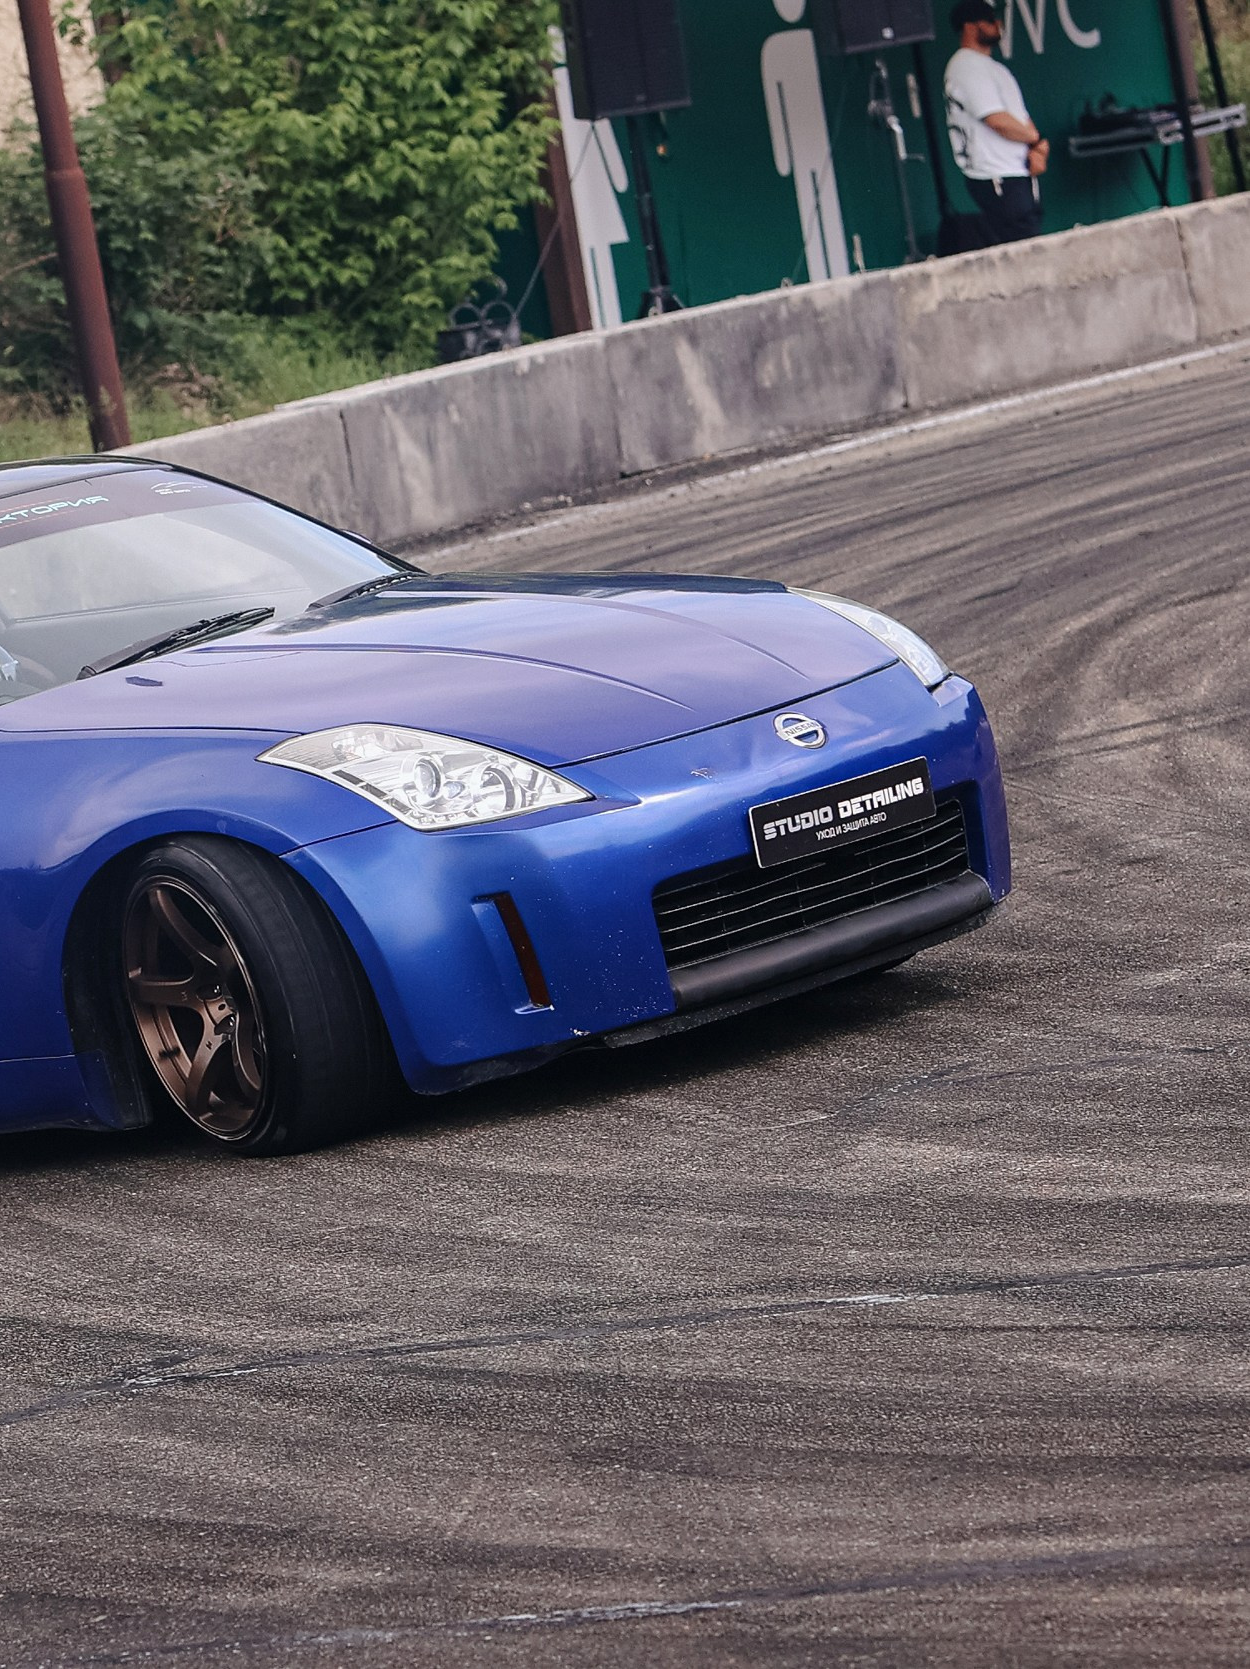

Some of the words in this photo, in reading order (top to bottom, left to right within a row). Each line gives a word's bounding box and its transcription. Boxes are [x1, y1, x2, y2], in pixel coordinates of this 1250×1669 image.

[785, 720, 820, 737] NISSAN
[763, 806, 833, 841] STUDIO
[838, 777, 924, 819] DETAILING
[815, 827, 836, 841] УХОД
[835, 825, 842, 835] И
[842, 817, 869, 833] ЗАЩИТА
[870, 811, 887, 825] АВТО
